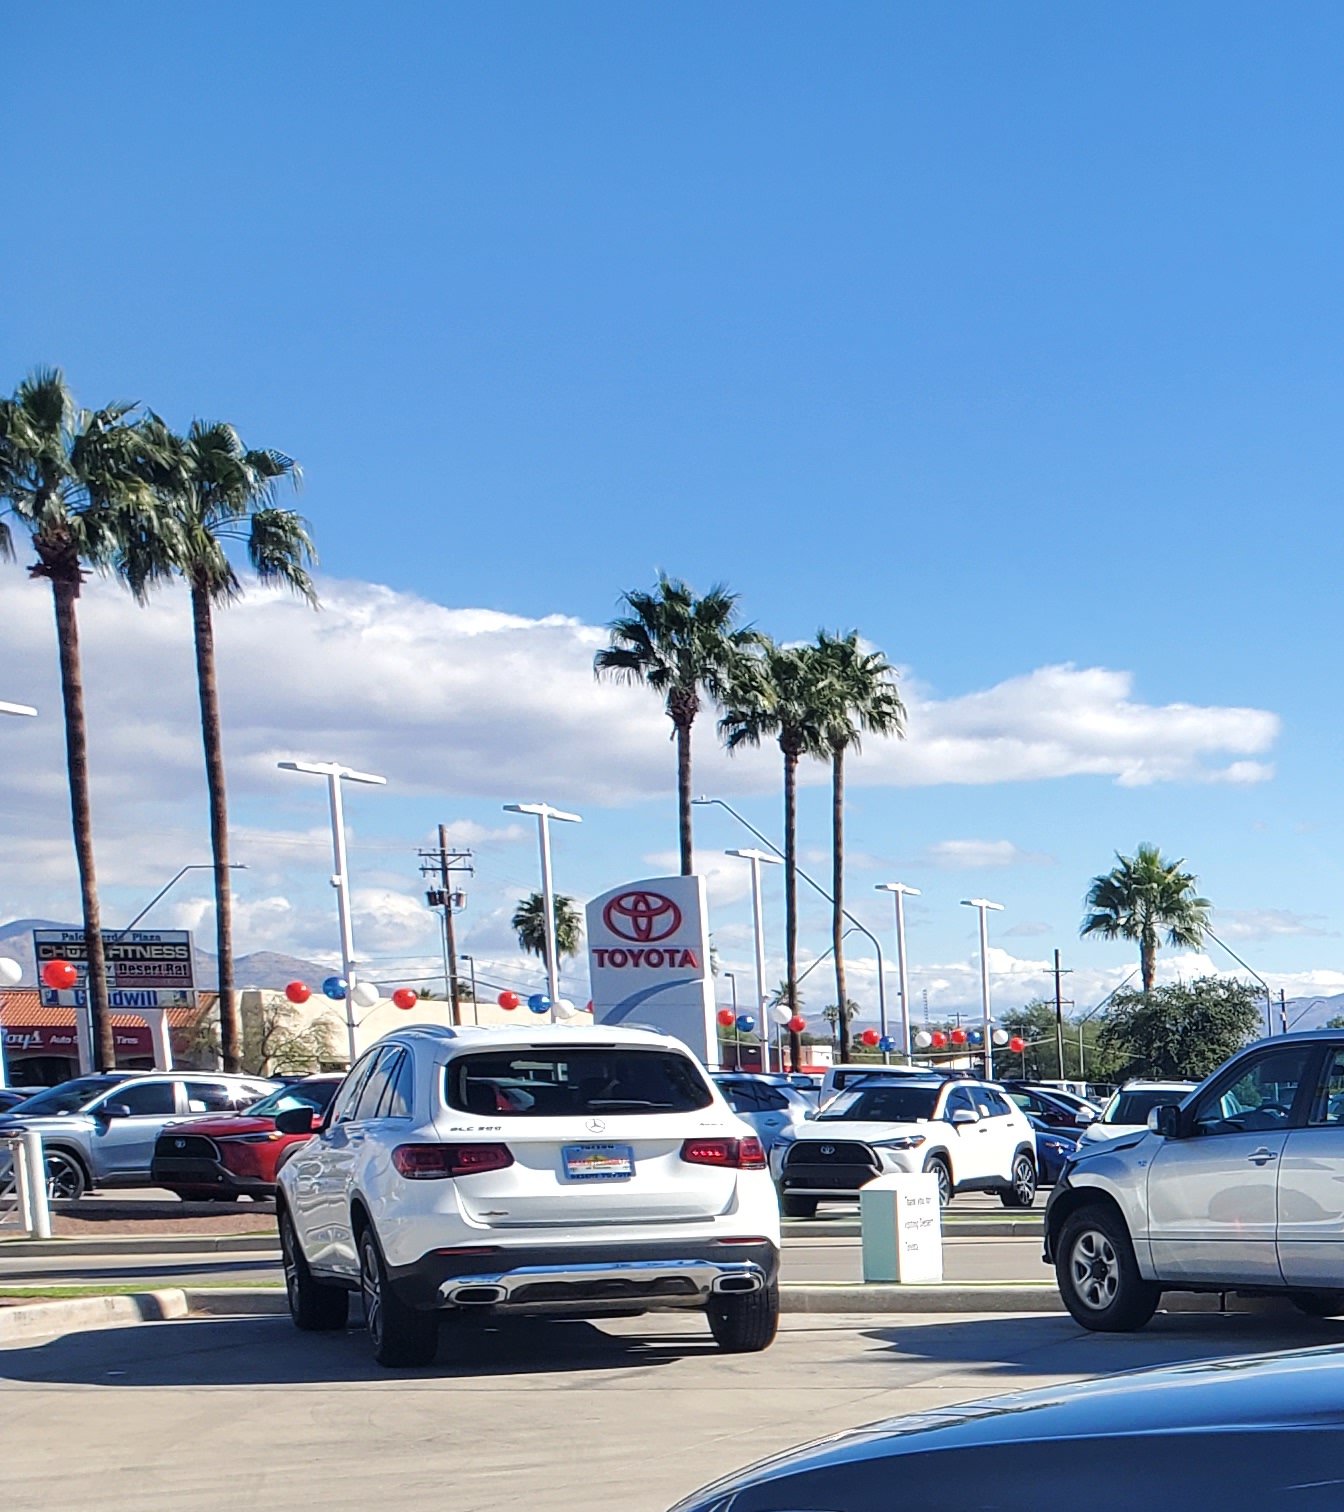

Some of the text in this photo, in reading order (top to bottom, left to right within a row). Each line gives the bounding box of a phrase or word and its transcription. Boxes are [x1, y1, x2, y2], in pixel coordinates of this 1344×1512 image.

[132, 932, 161, 942] Plaza
[592, 948, 698, 968] TOYOTA
[119, 963, 162, 975] Desert
[165, 963, 187, 976] Rat
